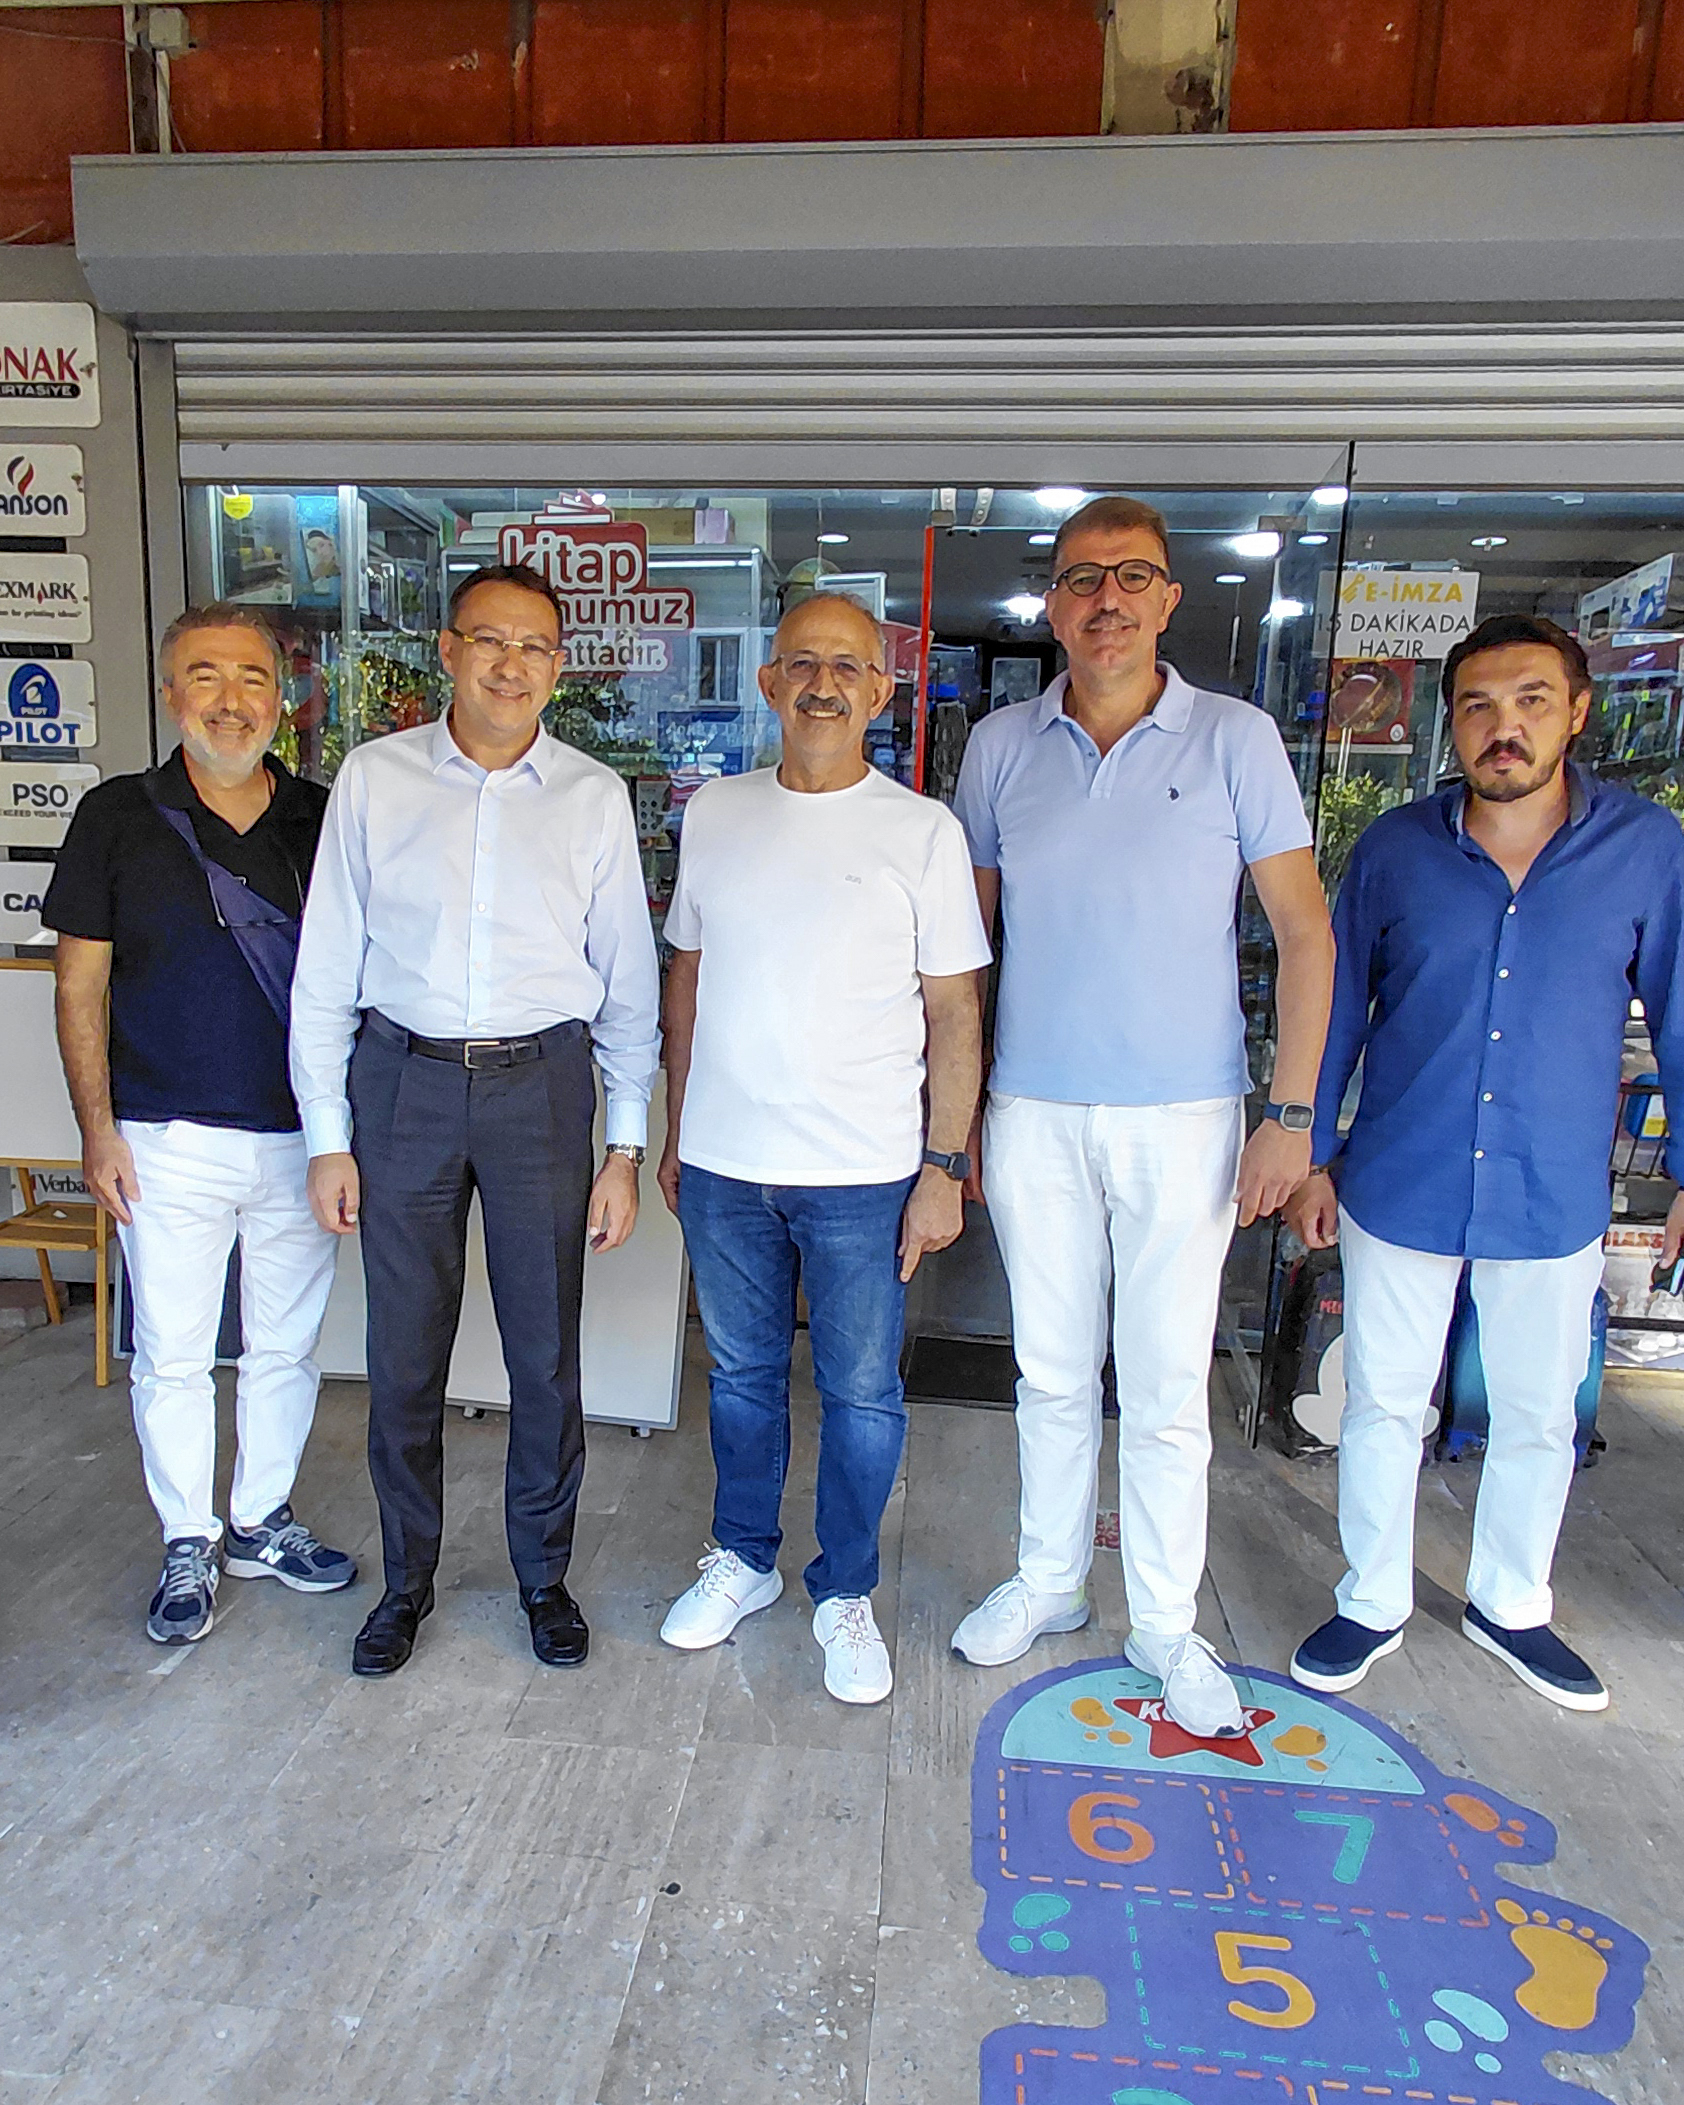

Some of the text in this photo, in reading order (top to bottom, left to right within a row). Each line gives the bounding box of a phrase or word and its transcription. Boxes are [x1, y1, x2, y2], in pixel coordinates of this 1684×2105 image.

[0, 346, 80, 382] NAK
[509, 535, 637, 596] kitap
[1366, 575, 1463, 603] E-İMZA
[1350, 609, 1471, 634] DAKİKADA
[1358, 639, 1424, 658] HAZIR
[0, 721, 81, 744] PILOT
[12, 783, 69, 808] PSO
[3, 893, 43, 912] CA
[38, 1173, 91, 1193] Verba
[1068, 1793, 1155, 1864] 6
[1294, 1811, 1375, 1885] 7
[1214, 1932, 1316, 2029] 5
